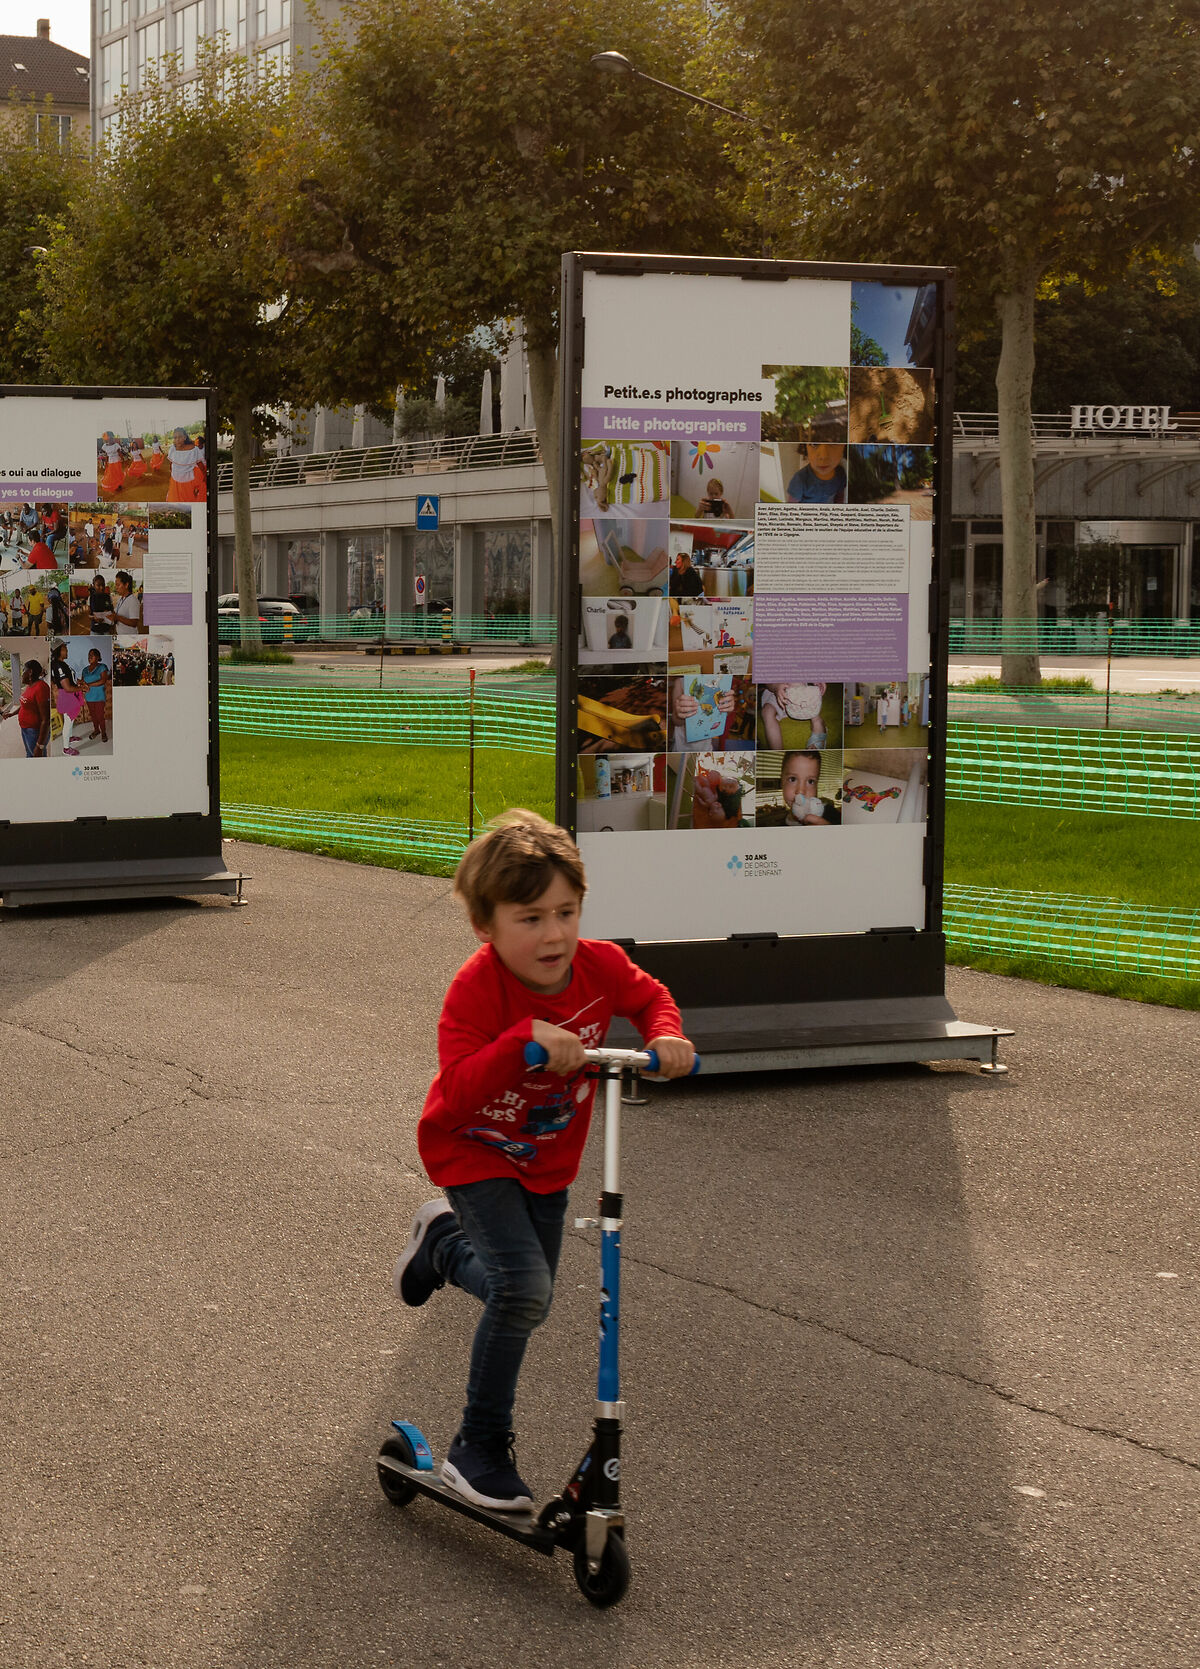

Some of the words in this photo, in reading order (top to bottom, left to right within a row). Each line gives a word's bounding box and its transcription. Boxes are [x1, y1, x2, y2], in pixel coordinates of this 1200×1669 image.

[604, 385, 662, 399] Petit.e.s
[666, 388, 762, 404] photographes
[604, 416, 640, 430] Little
[644, 417, 747, 434] photographers
[1070, 405, 1178, 430] HOTEL
[9, 468, 24, 476] oui
[41, 468, 82, 478] dialogue
[2, 489, 17, 498] yes
[20, 488, 30, 496] to
[32, 488, 73, 498] dialogue
[579, 1022, 600, 1040] MY
